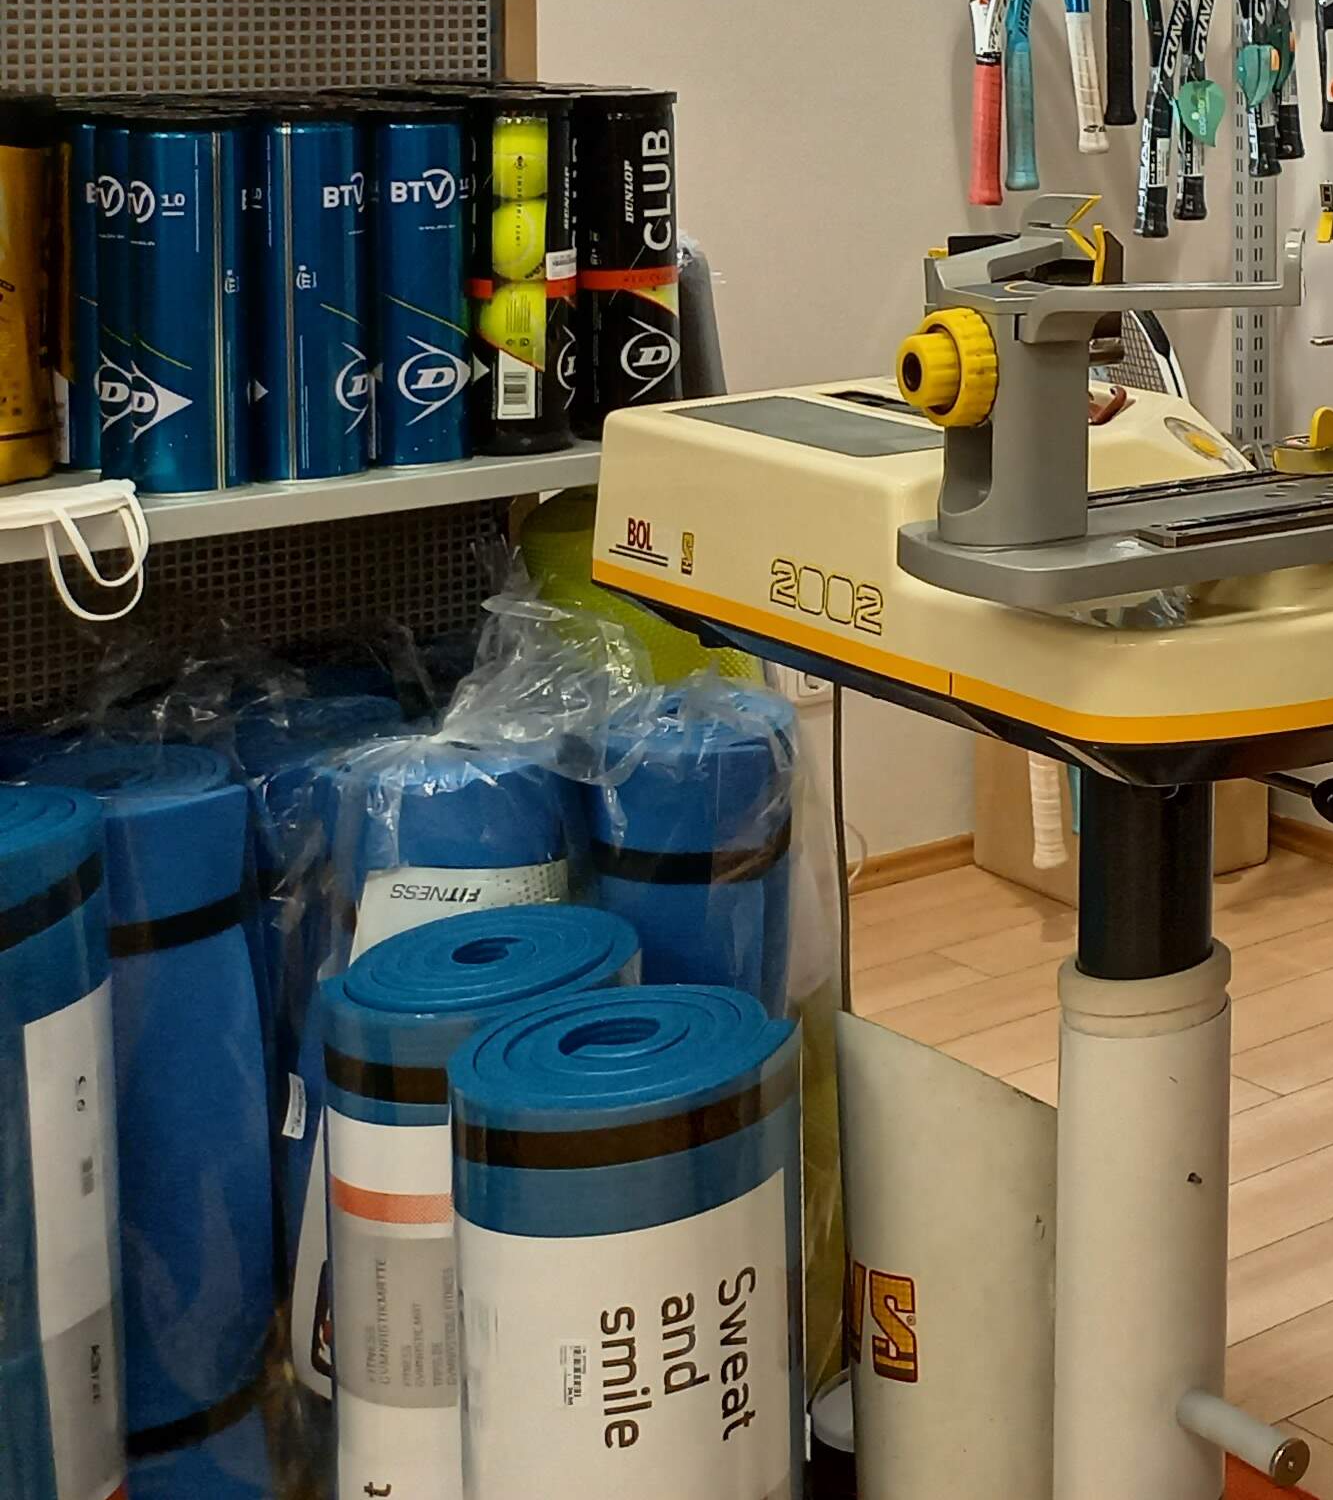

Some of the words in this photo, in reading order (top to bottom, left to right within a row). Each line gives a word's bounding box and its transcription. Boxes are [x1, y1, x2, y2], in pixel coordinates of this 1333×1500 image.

[390, 168, 456, 209] BTV
[624, 158, 635, 225] DUNLOP
[641, 127, 674, 252] CLUB
[627, 517, 653, 552] BOL
[769, 558, 884, 636] 2002
[389, 880, 483, 907] FITNESS
[597, 1305, 640, 1452] smile
[660, 1293, 712, 1399] and
[715, 1265, 759, 1443] Sweat
